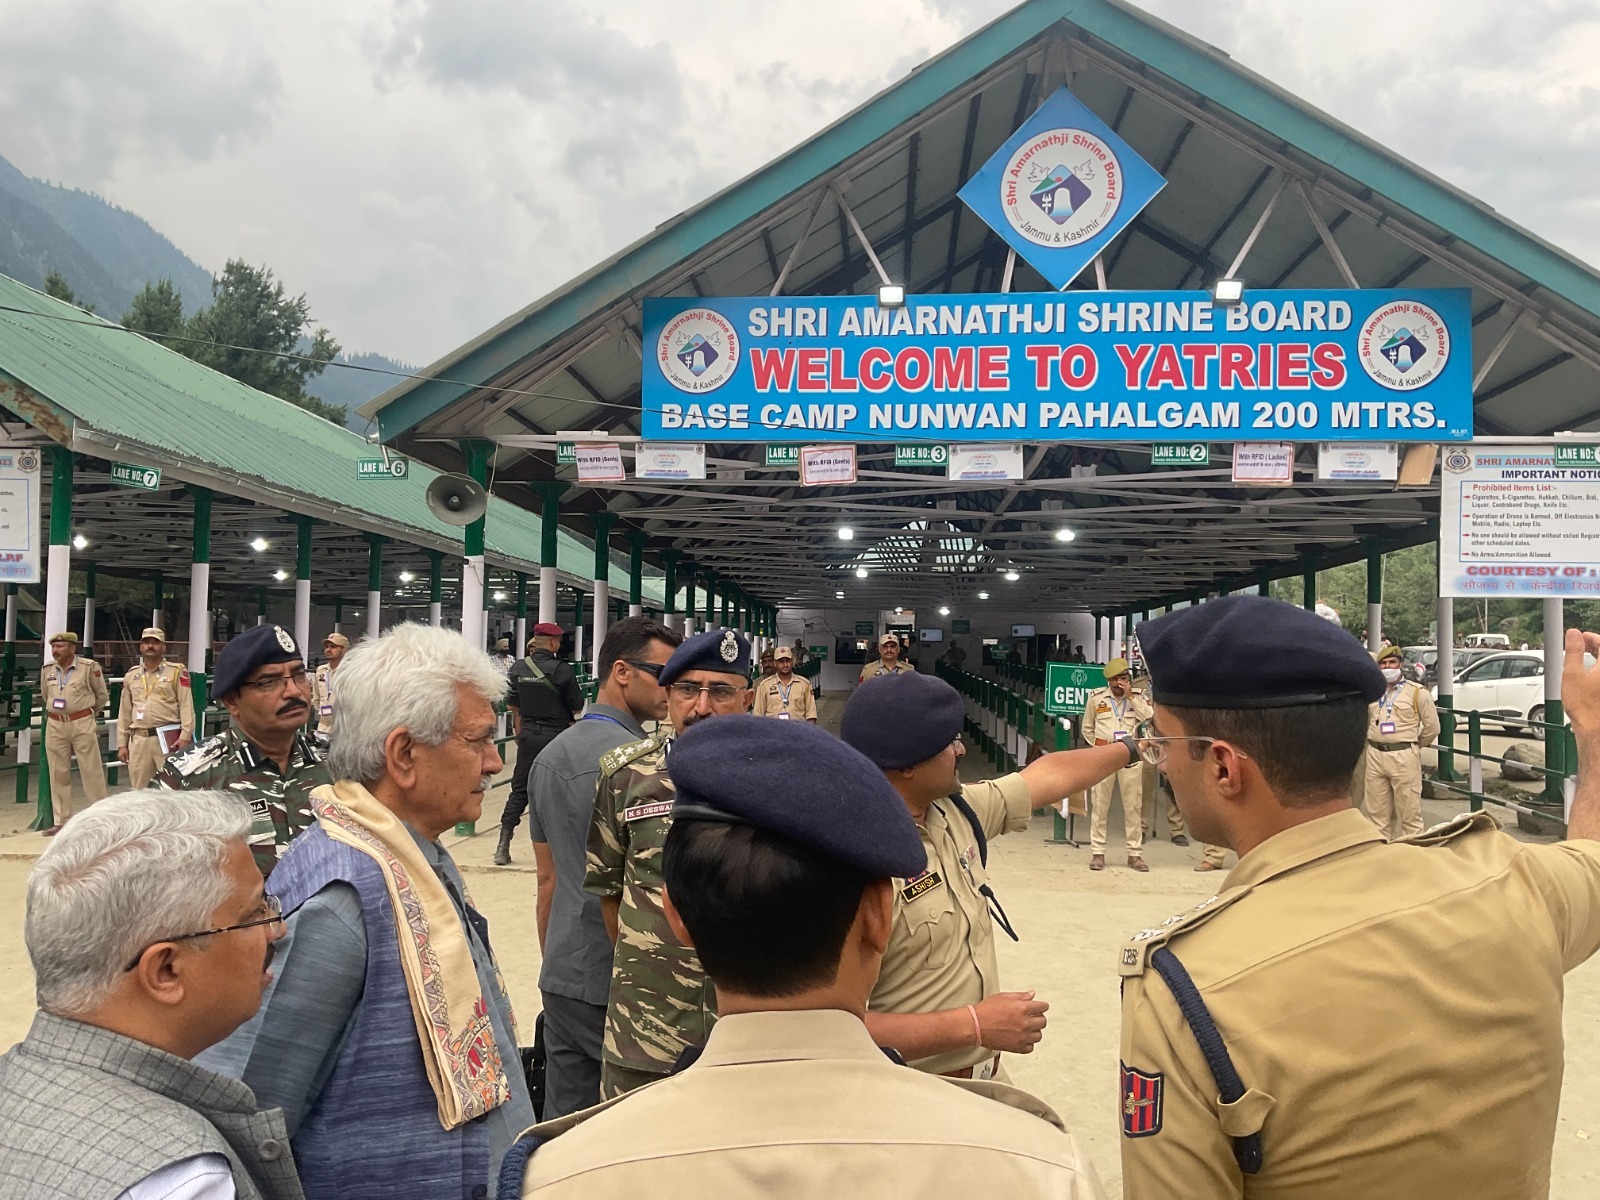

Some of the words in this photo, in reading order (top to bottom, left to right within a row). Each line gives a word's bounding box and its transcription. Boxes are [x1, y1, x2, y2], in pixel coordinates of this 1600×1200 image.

[1010, 133, 1069, 178] Amarnathji
[1072, 134, 1107, 161] Shrine
[1103, 161, 1117, 200] Board
[1006, 180, 1017, 206] Shri
[1020, 221, 1052, 242] Jammu
[1053, 232, 1060, 243] &
[1063, 218, 1100, 242] Kashmir
[706, 312, 729, 334] Shrine
[748, 307, 827, 337] SHRI
[838, 303, 1066, 336] AMARNATHJI
[1077, 301, 1213, 333] SHRINE
[1226, 300, 1352, 332] BOARD
[1365, 304, 1410, 336] Amarnathji
[1412, 305, 1438, 327] Shrine
[663, 312, 704, 342] Amarnathji
[727, 333, 736, 361] Board
[1363, 337, 1371, 357] Shri
[1436, 327, 1446, 356] Board
[661, 343, 669, 362] Shri
[750, 345, 1010, 393] WELCOME
[1025, 344, 1099, 391] TO
[1113, 342, 1347, 391] YATRIES
[1373, 368, 1396, 386] Jammu
[1398, 378, 1404, 387] &
[1405, 369, 1433, 386] Kashmir
[670, 372, 692, 389] Jammu
[693, 382, 698, 390] &
[700, 374, 724, 389] Kashmir
[661, 403, 750, 430] BASE
[760, 403, 858, 430] CAMP
[869, 403, 1027, 430] NUNWAN
[1039, 402, 1240, 429] PAHALGAM
[1252, 401, 1319, 429] 200
[1331, 401, 1446, 429] MTRS.
[769, 447, 787, 459] LANE
[898, 447, 916, 458] LANE
[918, 447, 931, 459] NO:
[934, 447, 943, 460] 3
[1154, 446, 1173, 457] LANE
[1175, 446, 1189, 457] NO:
[1193, 446, 1203, 459] 2
[1476, 458, 1502, 466] SHRI
[1558, 448, 1578, 459] LANE
[1580, 448, 1594, 459] NO:
[112, 467, 130, 479] LANE
[131, 470, 143, 481] NO:
[147, 472, 155, 484] 7
[359, 462, 377, 473] LANE
[394, 461, 403, 475] 6
[1501, 470, 1567, 479] IMPORTANT
[1466, 566, 1560, 577] COURTESY
[1563, 567, 1587, 577] OF
[911, 876, 935, 896] ASHISH
